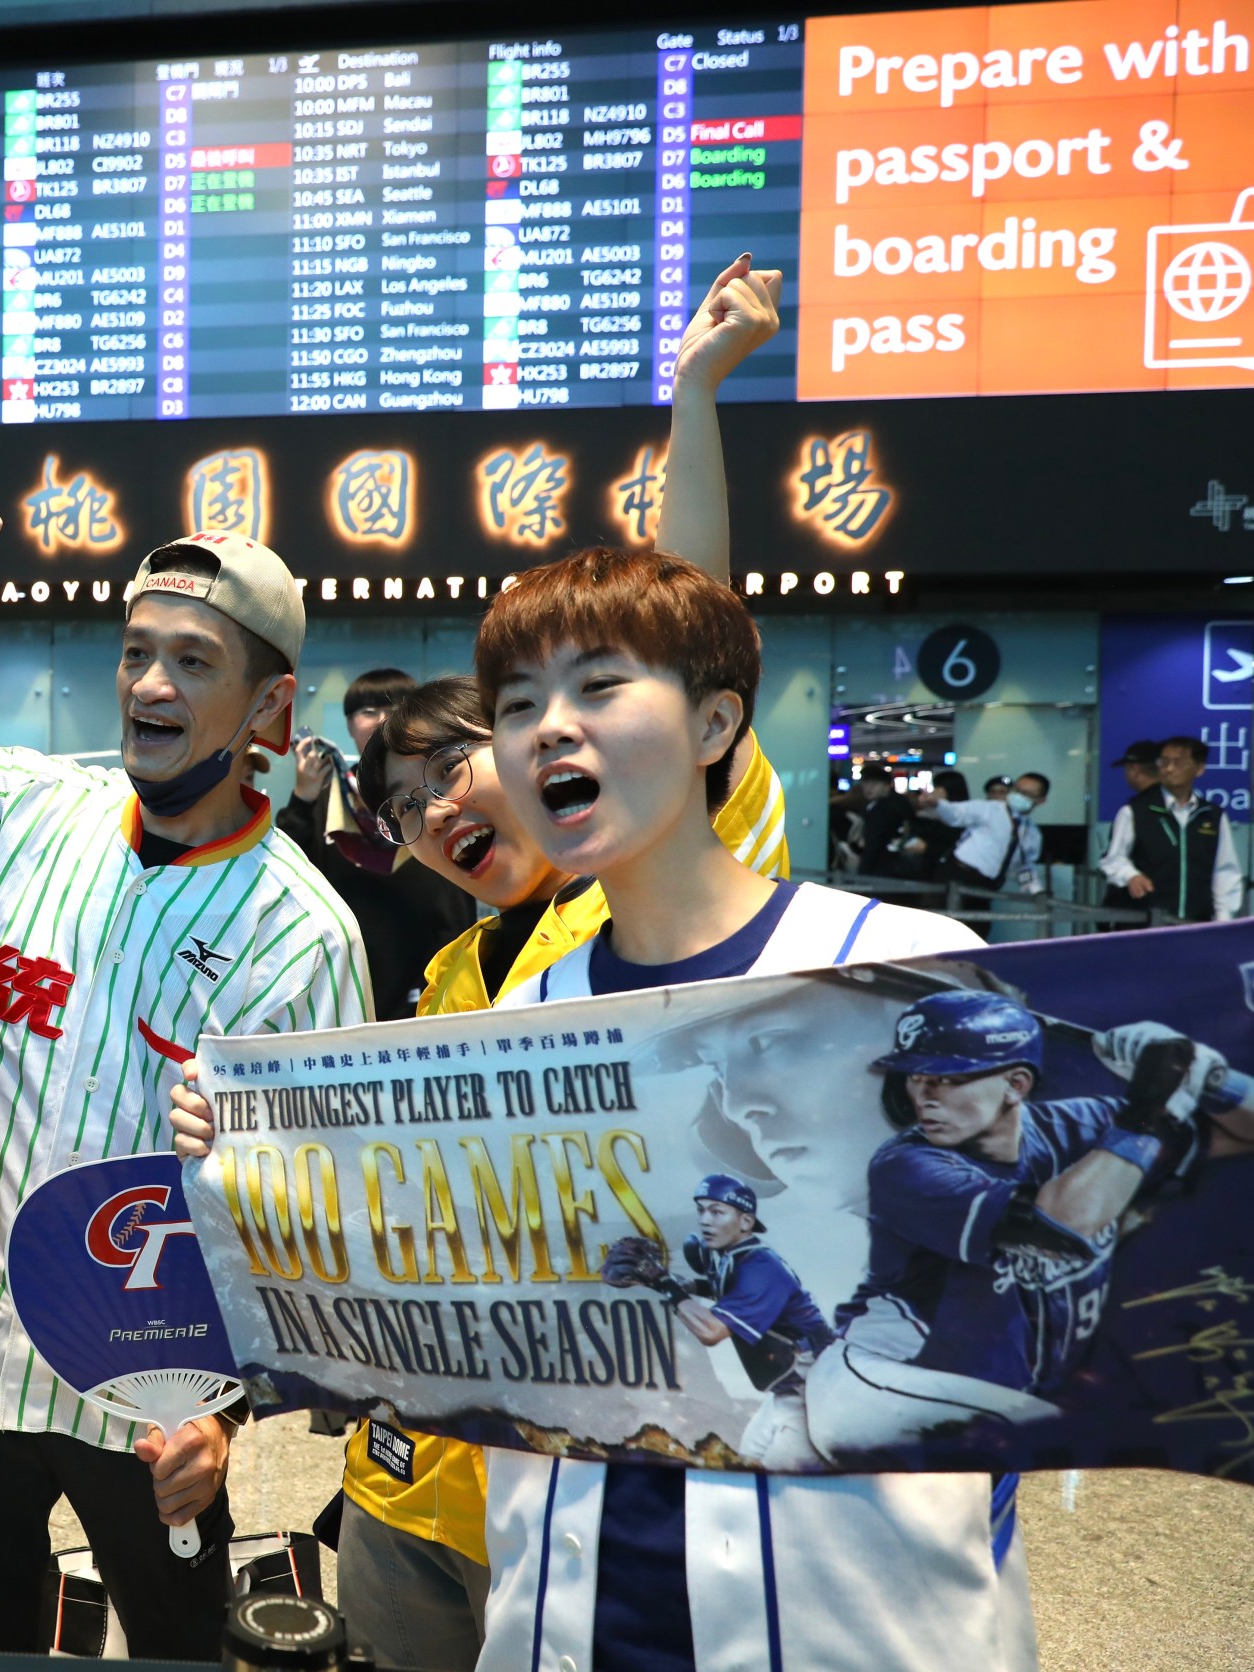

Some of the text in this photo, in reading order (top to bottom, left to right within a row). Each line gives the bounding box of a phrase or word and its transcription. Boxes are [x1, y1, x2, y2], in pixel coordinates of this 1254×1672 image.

[657, 33, 693, 49] Gate
[717, 25, 799, 46] Status 1/3
[488, 41, 562, 60] Flight info
[338, 51, 418, 69] Destination
[664, 56, 687, 72] C7
[692, 51, 748, 69] Closed
[838, 20, 1249, 108] Prepare with
[521, 62, 570, 79] BR255
[384, 73, 411, 88] Bali
[521, 85, 570, 102] BR801
[384, 94, 433, 111] Macau
[663, 103, 686, 119] C3
[520, 108, 570, 125] BR118
[584, 105, 646, 121] NZ4910
[384, 117, 433, 134] Sendai
[691, 121, 764, 140] Final Call
[663, 126, 686, 143] D5
[383, 141, 428, 158] Tokyo
[662, 150, 685, 166] D7
[691, 145, 765, 166] Boarding
[520, 156, 568, 171] TK125
[583, 152, 642, 168] BR3807
[835, 120, 1190, 204] passport &
[382, 163, 440, 179] Istanbul
[691, 168, 765, 189] Boarding
[520, 179, 559, 195] DL68
[662, 173, 685, 189] D6
[382, 186, 433, 202] Seattle
[582, 199, 641, 215] AE5101
[661, 197, 685, 213] D1
[382, 209, 436, 225] Xiamen
[519, 225, 570, 241] UA872
[661, 220, 684, 236] D4
[382, 230, 471, 246] San Francisco
[519, 249, 574, 265] MU201
[660, 244, 684, 260] D9
[834, 216, 1117, 284] boarding
[382, 255, 436, 272] Ningbo
[581, 269, 641, 286] TG6242
[660, 268, 684, 283] C4
[382, 277, 467, 294] Los Angeles
[659, 291, 684, 307] D2
[381, 301, 433, 317] Fuzhou
[380, 322, 469, 338] San Francisco
[580, 316, 641, 333] TG6256
[659, 315, 683, 330] C6
[832, 313, 966, 372] pass
[380, 345, 462, 364] Zhengzhou
[380, 368, 462, 386] Hong Kong
[517, 365, 568, 381] HX253
[379, 391, 463, 408] Guangzhou
[146, 577, 195, 592] CANADA
[746, 571, 915, 595] RPORT
[942, 639, 976, 687] 6
[1201, 722, 1250, 771] 出
[176, 949, 218, 983] MIZUNO
[213, 1028, 624, 1077] 95 戴培峰 中職史上最年輕捕手 單季百場蹲捕
[214, 1062, 637, 1133] THE YOUNGEST PLAYER TO CATCH
[219, 1128, 672, 1285] 100 GAMES
[147, 1319, 166, 1327] WBSC
[256, 1286, 683, 1392] IN A SINGLE SEASON
[371, 1422, 393, 1448] TAIPEI
[392, 1435, 410, 1461] DOME
